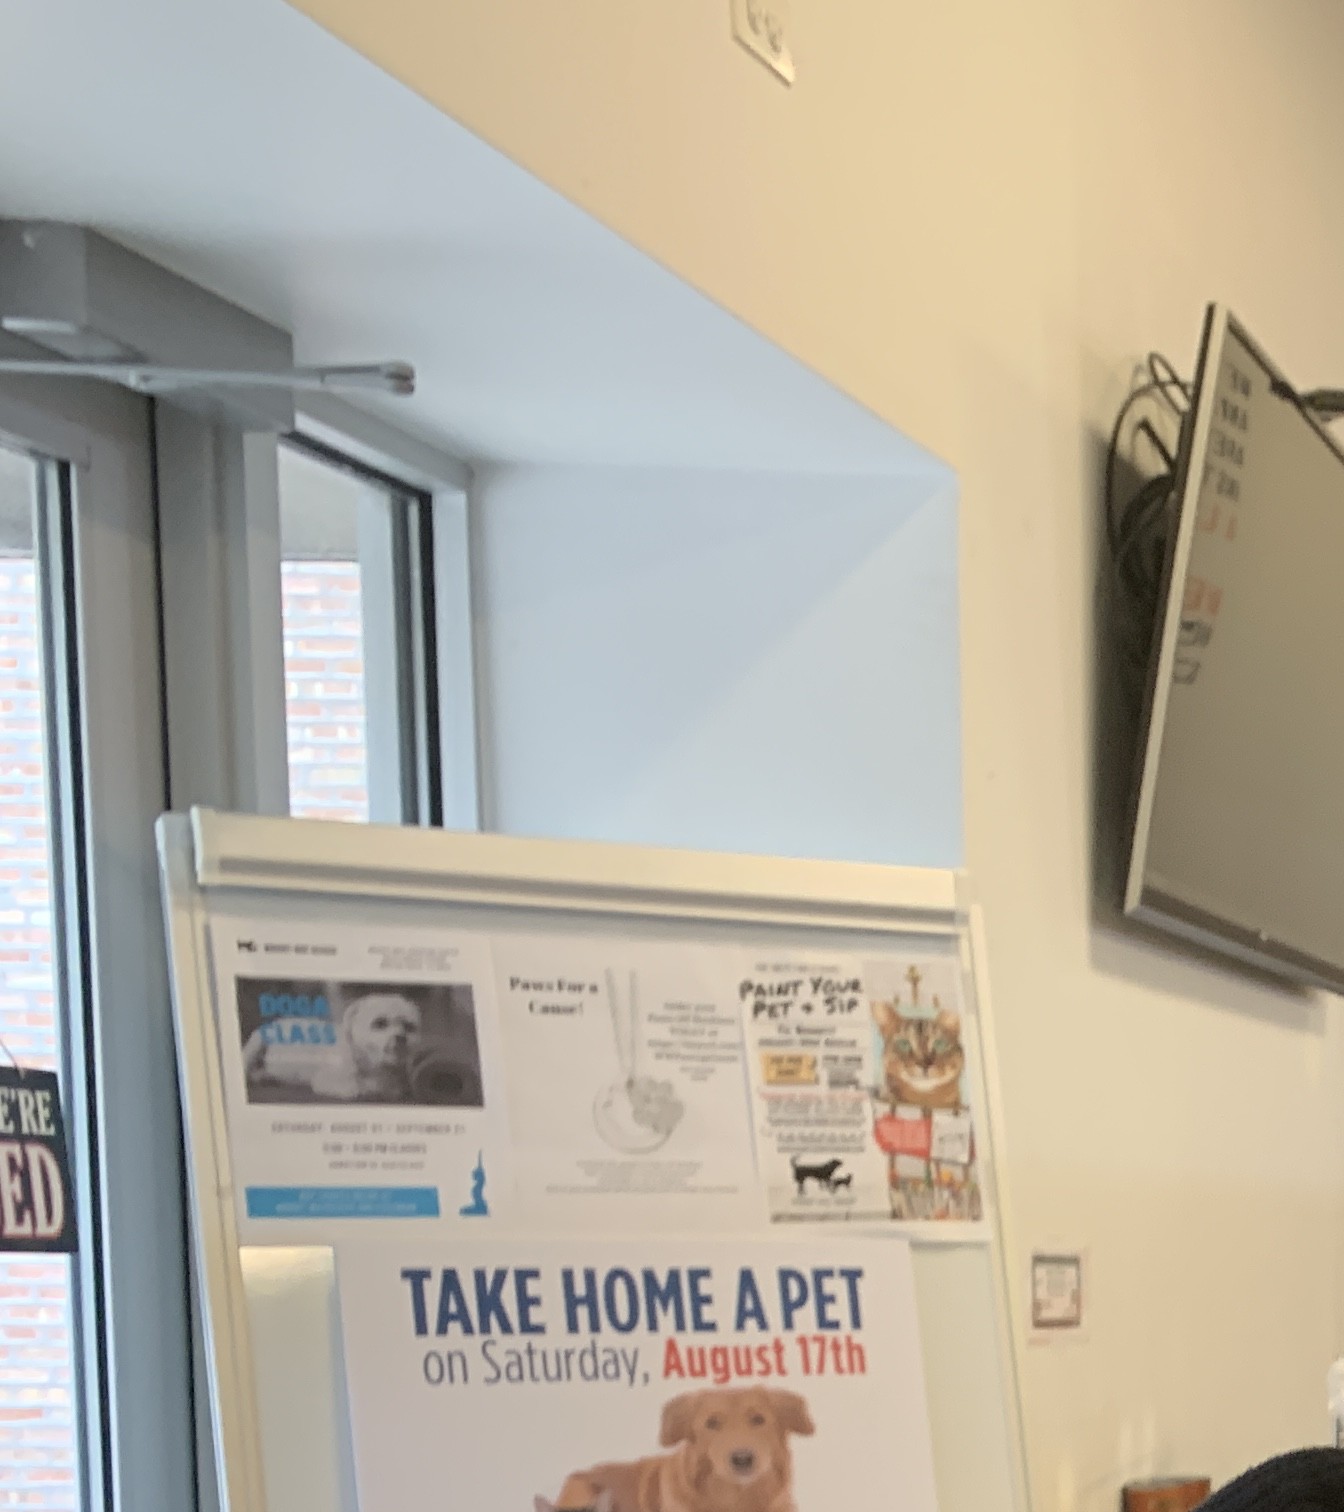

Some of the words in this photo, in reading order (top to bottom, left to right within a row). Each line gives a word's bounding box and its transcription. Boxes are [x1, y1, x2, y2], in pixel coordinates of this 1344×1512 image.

[738, 979, 802, 1000] PAINT
[811, 976, 861, 994] YOUR
[752, 1003, 796, 1021] PET
[825, 998, 859, 1017] SIP
[259, 1022, 337, 1046] CLASS
[0, 1140, 64, 1238] ED
[401, 1267, 546, 1336] TAKE
[561, 1267, 717, 1334] HOME
[735, 1267, 769, 1332] A
[778, 1267, 865, 1331] PET
[423, 1346, 470, 1386] on
[482, 1338, 650, 1387] Saturday,
[662, 1335, 788, 1385] August
[797, 1333, 867, 1377] 17th
